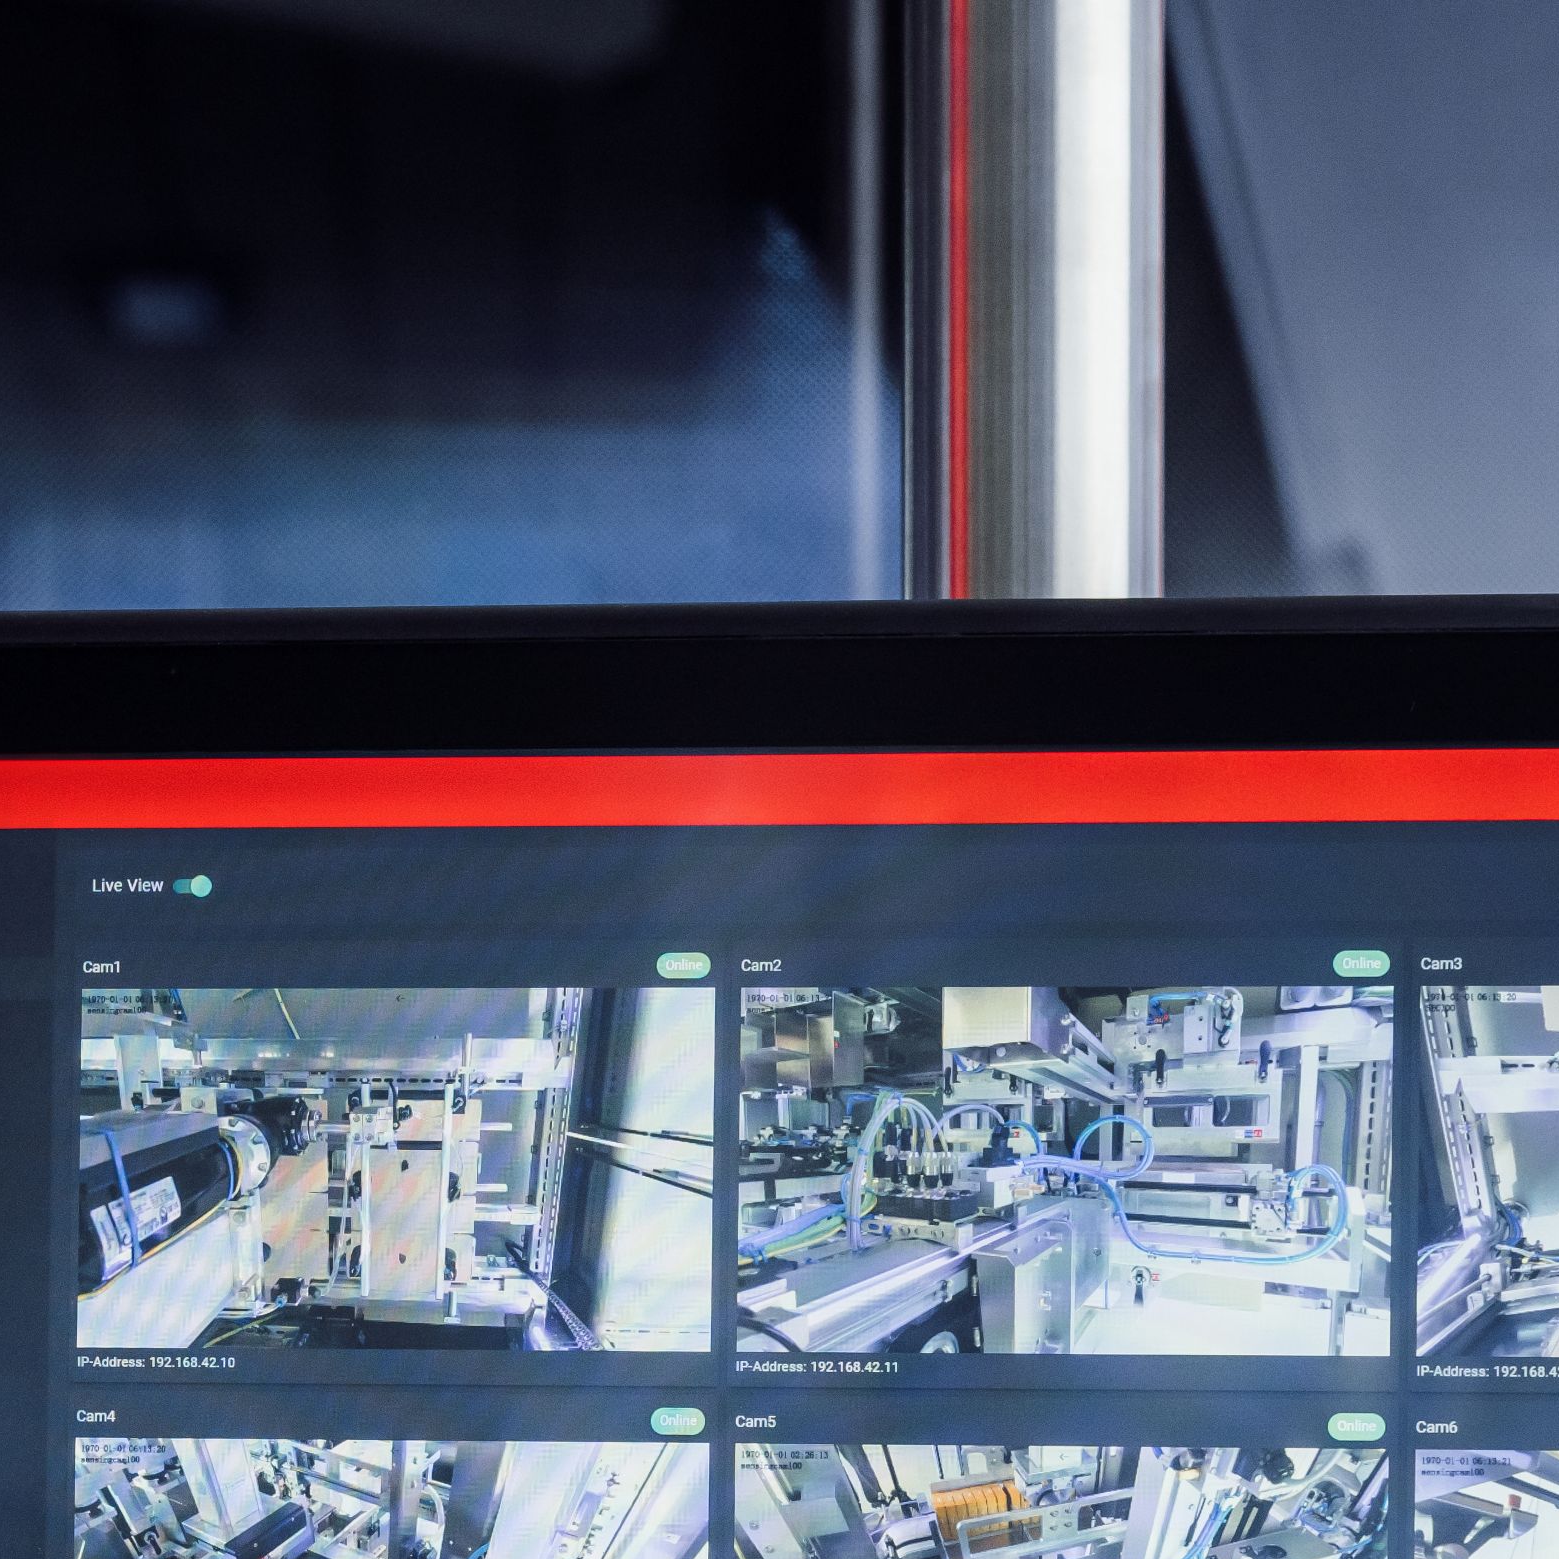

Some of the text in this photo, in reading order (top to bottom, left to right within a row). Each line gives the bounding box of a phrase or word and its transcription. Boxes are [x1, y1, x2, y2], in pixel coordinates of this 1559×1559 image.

[92, 878, 164, 893] Live View
[83, 960, 121, 974] Cam1
[665, 958, 703, 971] Online
[741, 959, 782, 972] Cam2
[1342, 957, 1382, 969] Online
[1420, 957, 1463, 970] Cam3
[77, 1356, 236, 1368] IP-Address: 192.168.42.10
[735, 1361, 899, 1373] IP-Address: 192.168.42.11
[1416, 1365, 1490, 1377] IP-Address:
[76, 1410, 116, 1422] Cam4
[660, 1413, 698, 1426] Online
[735, 1415, 777, 1428] Cam5
[1337, 1419, 1377, 1431] Online
[1415, 1420, 1458, 1434] Cam6
